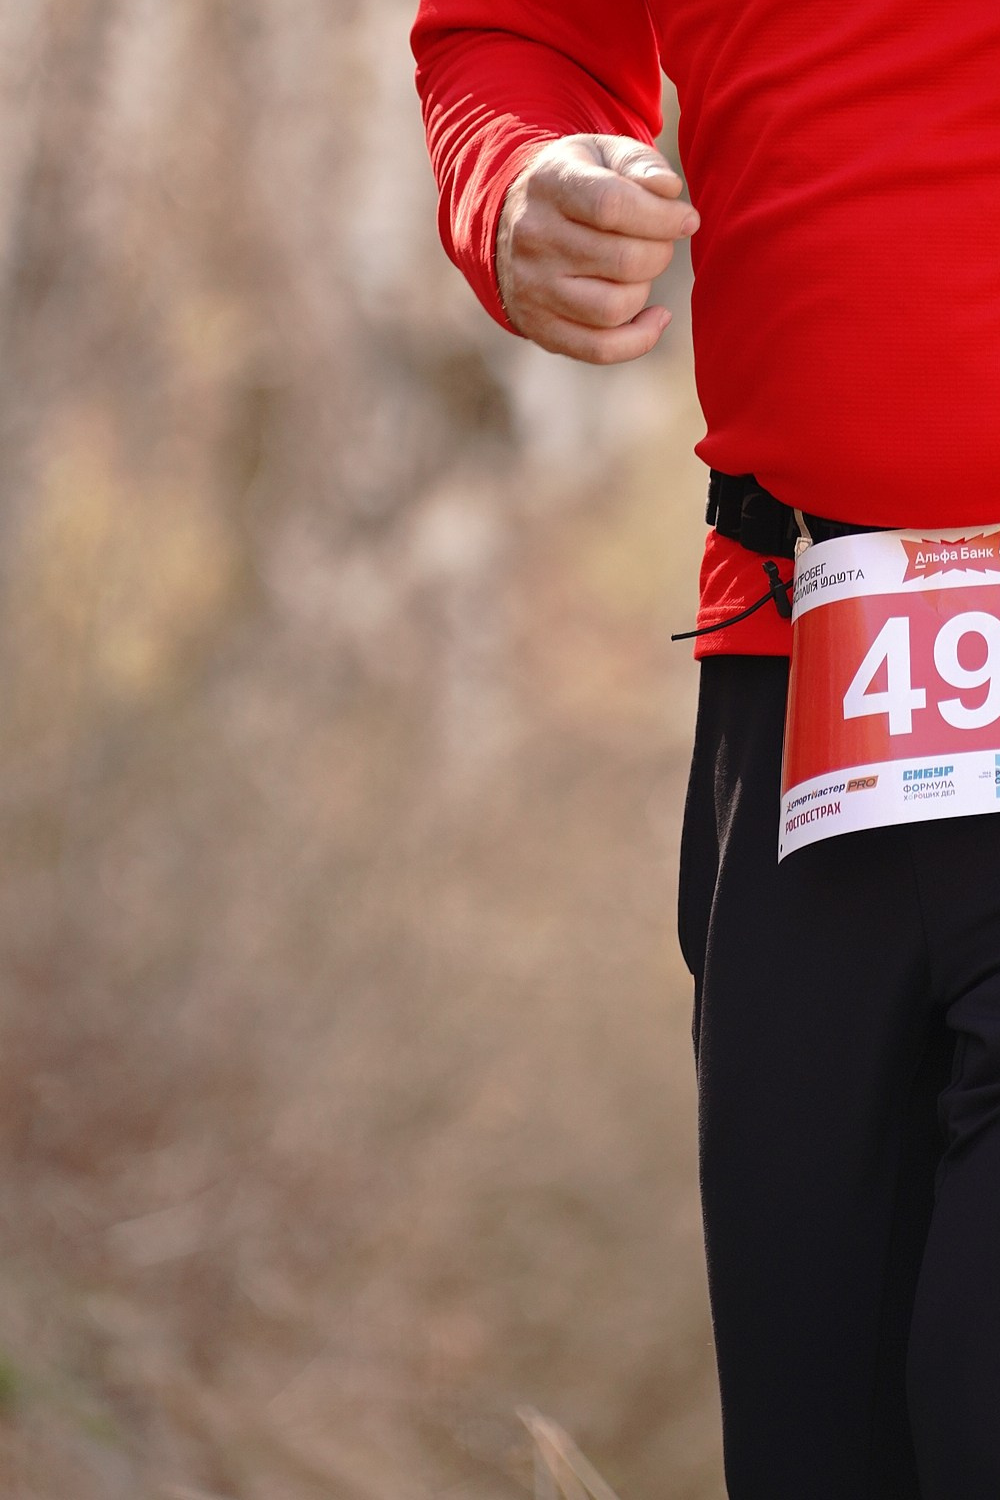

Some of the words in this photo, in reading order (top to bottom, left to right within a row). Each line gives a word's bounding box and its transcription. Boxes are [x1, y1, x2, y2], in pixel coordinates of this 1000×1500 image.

[914, 549, 958, 569] Альфа
[960, 547, 994, 560] Банк
[902, 765, 954, 781] СИБУР
[848, 778, 876, 791] PRO
[902, 780, 955, 794] ФОРМУЛА
[941, 789, 956, 798] ДЕЛ
[785, 801, 841, 835] РОСГОССТРАХ
